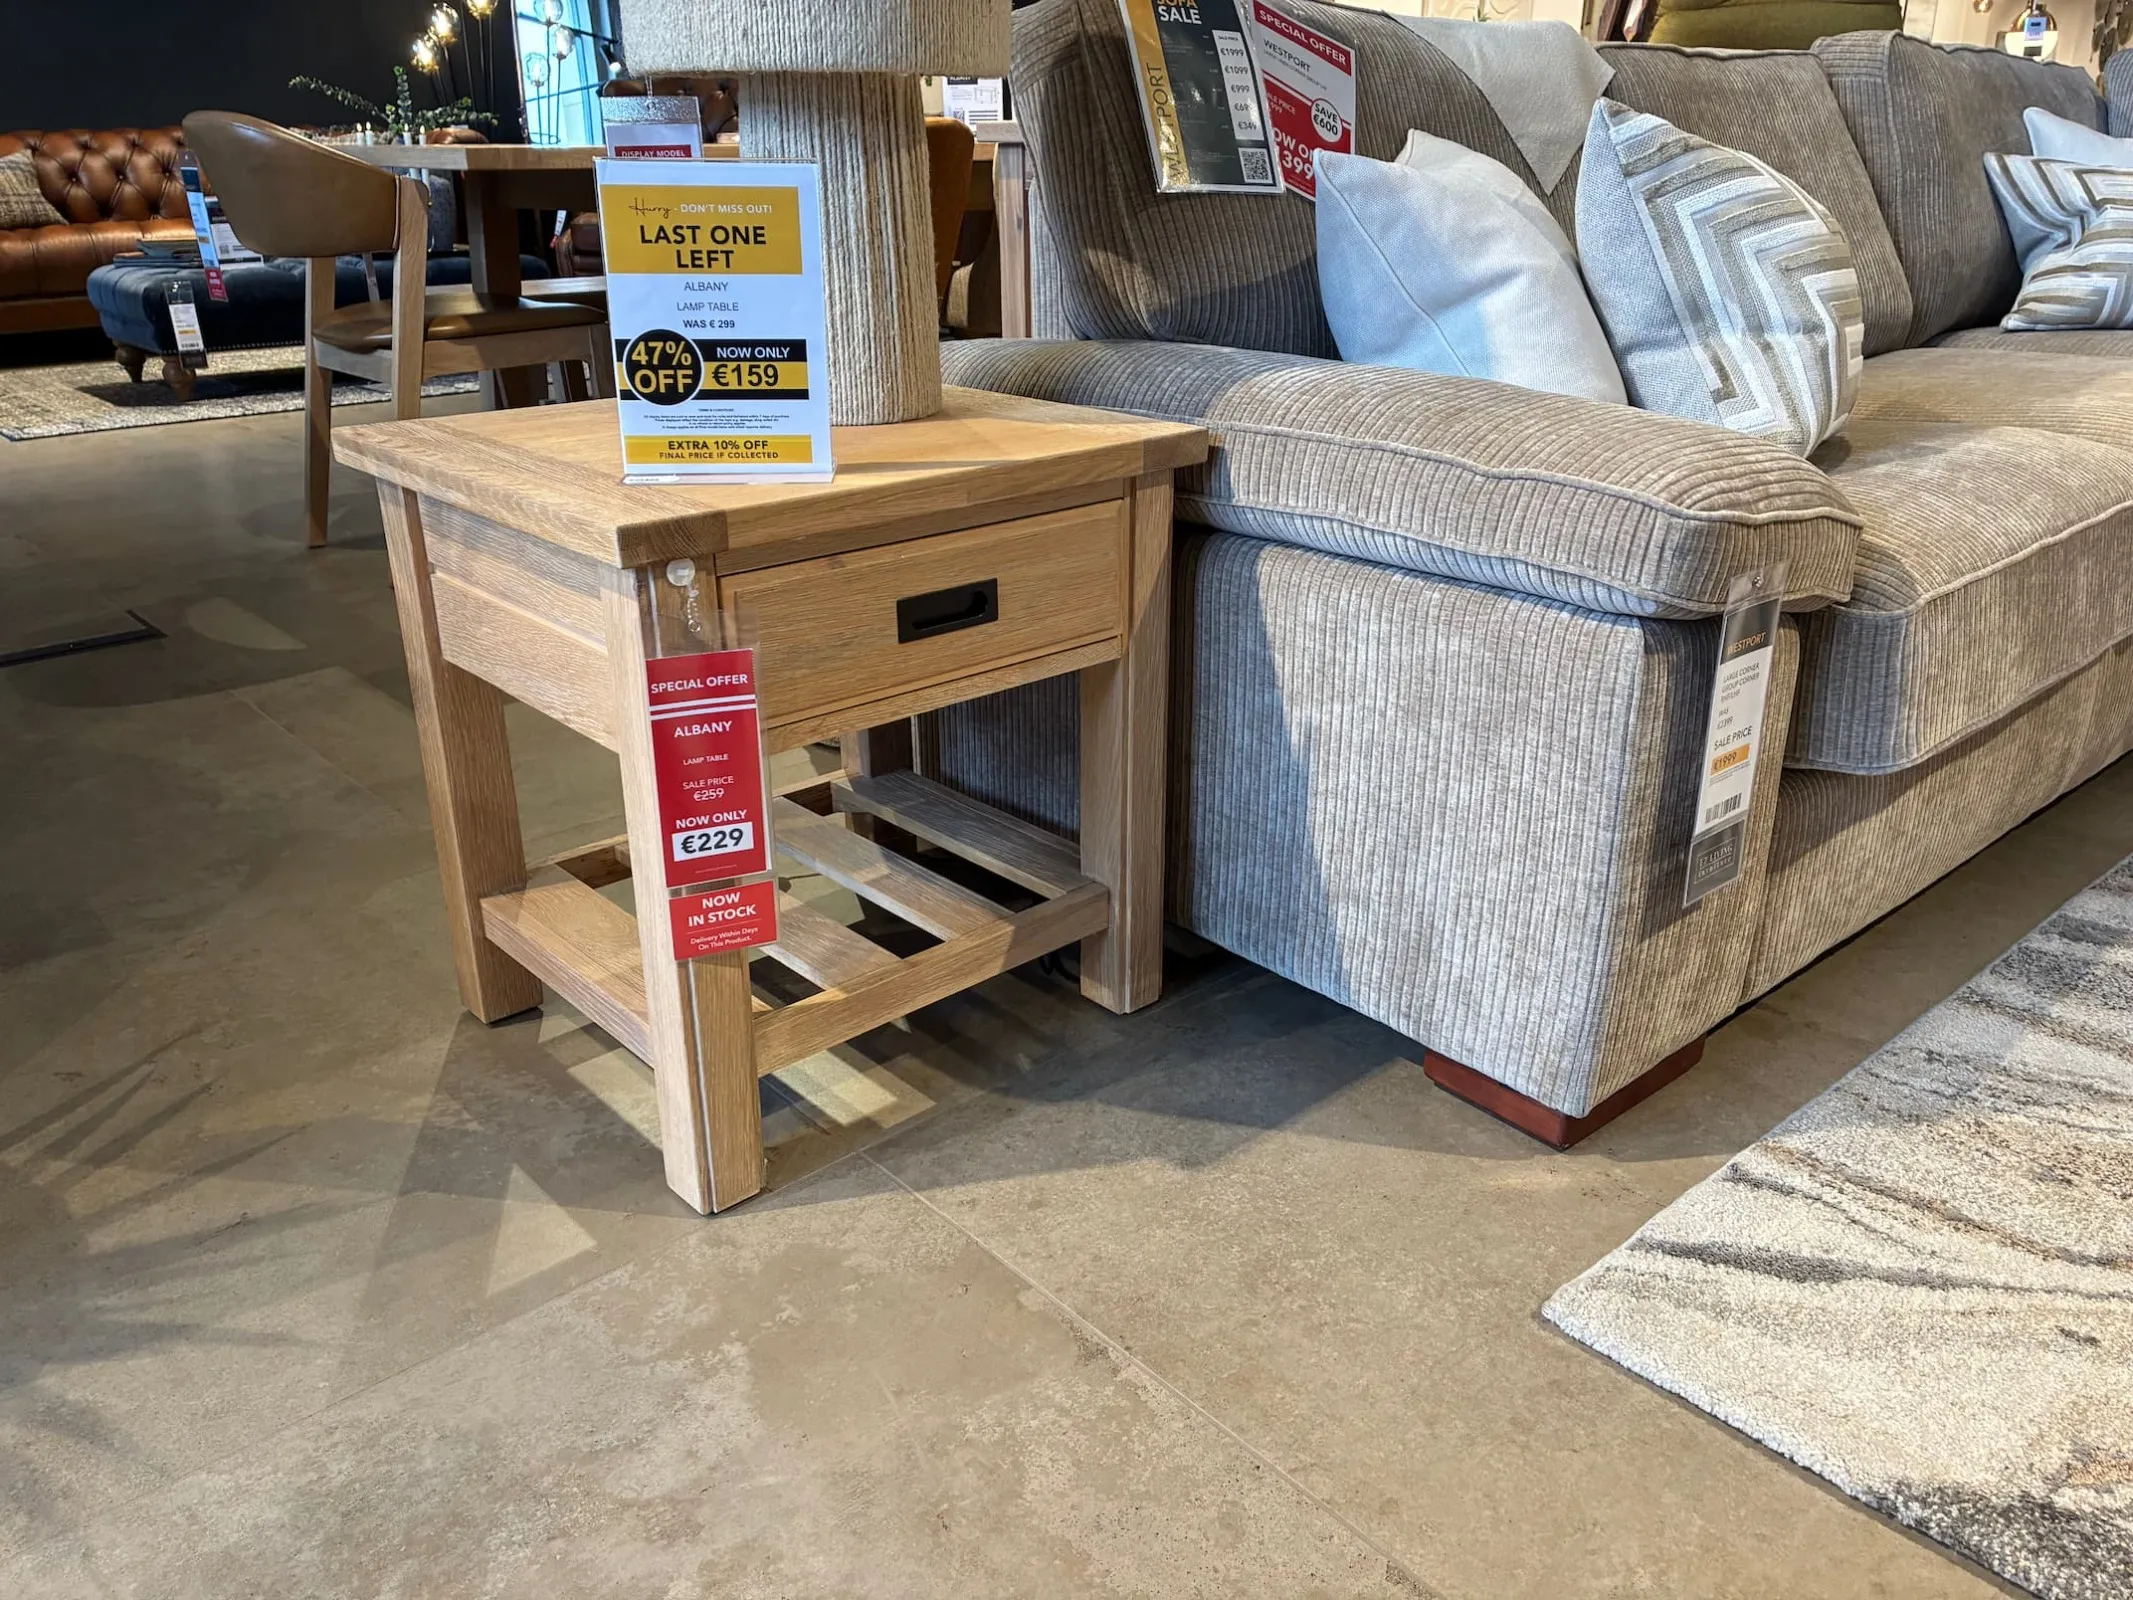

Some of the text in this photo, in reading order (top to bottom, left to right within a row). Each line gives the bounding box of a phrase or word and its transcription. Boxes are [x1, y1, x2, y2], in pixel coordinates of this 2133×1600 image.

[1158, 5, 1202, 25] SALE
[1260, 10, 1309, 43] SPECIAL
[1309, 38, 1346, 66] OFFER
[1220, 47, 1244, 56] €1999
[1263, 37, 1311, 72] WESTPORT
[1225, 65, 1249, 74] €1099
[1230, 84, 1250, 94] €999
[1234, 103, 1252, 111] €69
[1315, 103, 1338, 124] SAVE
[1313, 114, 1339, 136] €600
[1273, 127, 1297, 150] OW
[621, 149, 686, 158] DISPLAY MODEL
[1278, 146, 1314, 180] 399
[628, 198, 671, 219] Hurry
[680, 203, 715, 213] DON'T
[718, 204, 743, 214] MISS
[746, 205, 772, 214] OUT!
[640, 225, 767, 245] LAST ONE
[676, 250, 735, 269] LEFT
[684, 281, 729, 291] ALBANY
[677, 302, 739, 311] LAMP TABLE
[683, 319, 707, 329] WAS
[717, 319, 735, 329] 299
[631, 341, 692, 365] 47%
[716, 347, 790, 359] NOW ONLY
[634, 369, 693, 394] OFF
[712, 364, 779, 387] €159
[668, 440, 769, 450] EXTRA 10% OFF
[1727, 631, 1766, 655] WESTPORT
[1739, 662, 1760, 677] CORNER
[651, 673, 748, 694] SPECIAL OFFER
[674, 720, 733, 738] ALBANY
[1713, 725, 1753, 751] SALE PRICE
[683, 753, 729, 766] LAMP TABLE
[1714, 751, 1737, 771] €1999
[682, 775, 735, 790] SALE PRICE
[693, 787, 725, 802] €259
[675, 809, 748, 829] NOW ONLY
[681, 828, 744, 854] €229
[702, 892, 741, 909] NOW
[688, 904, 757, 927] IN STOCK
[690, 927, 759, 945] Delivery Within Days
[710, 940, 724, 948] This
